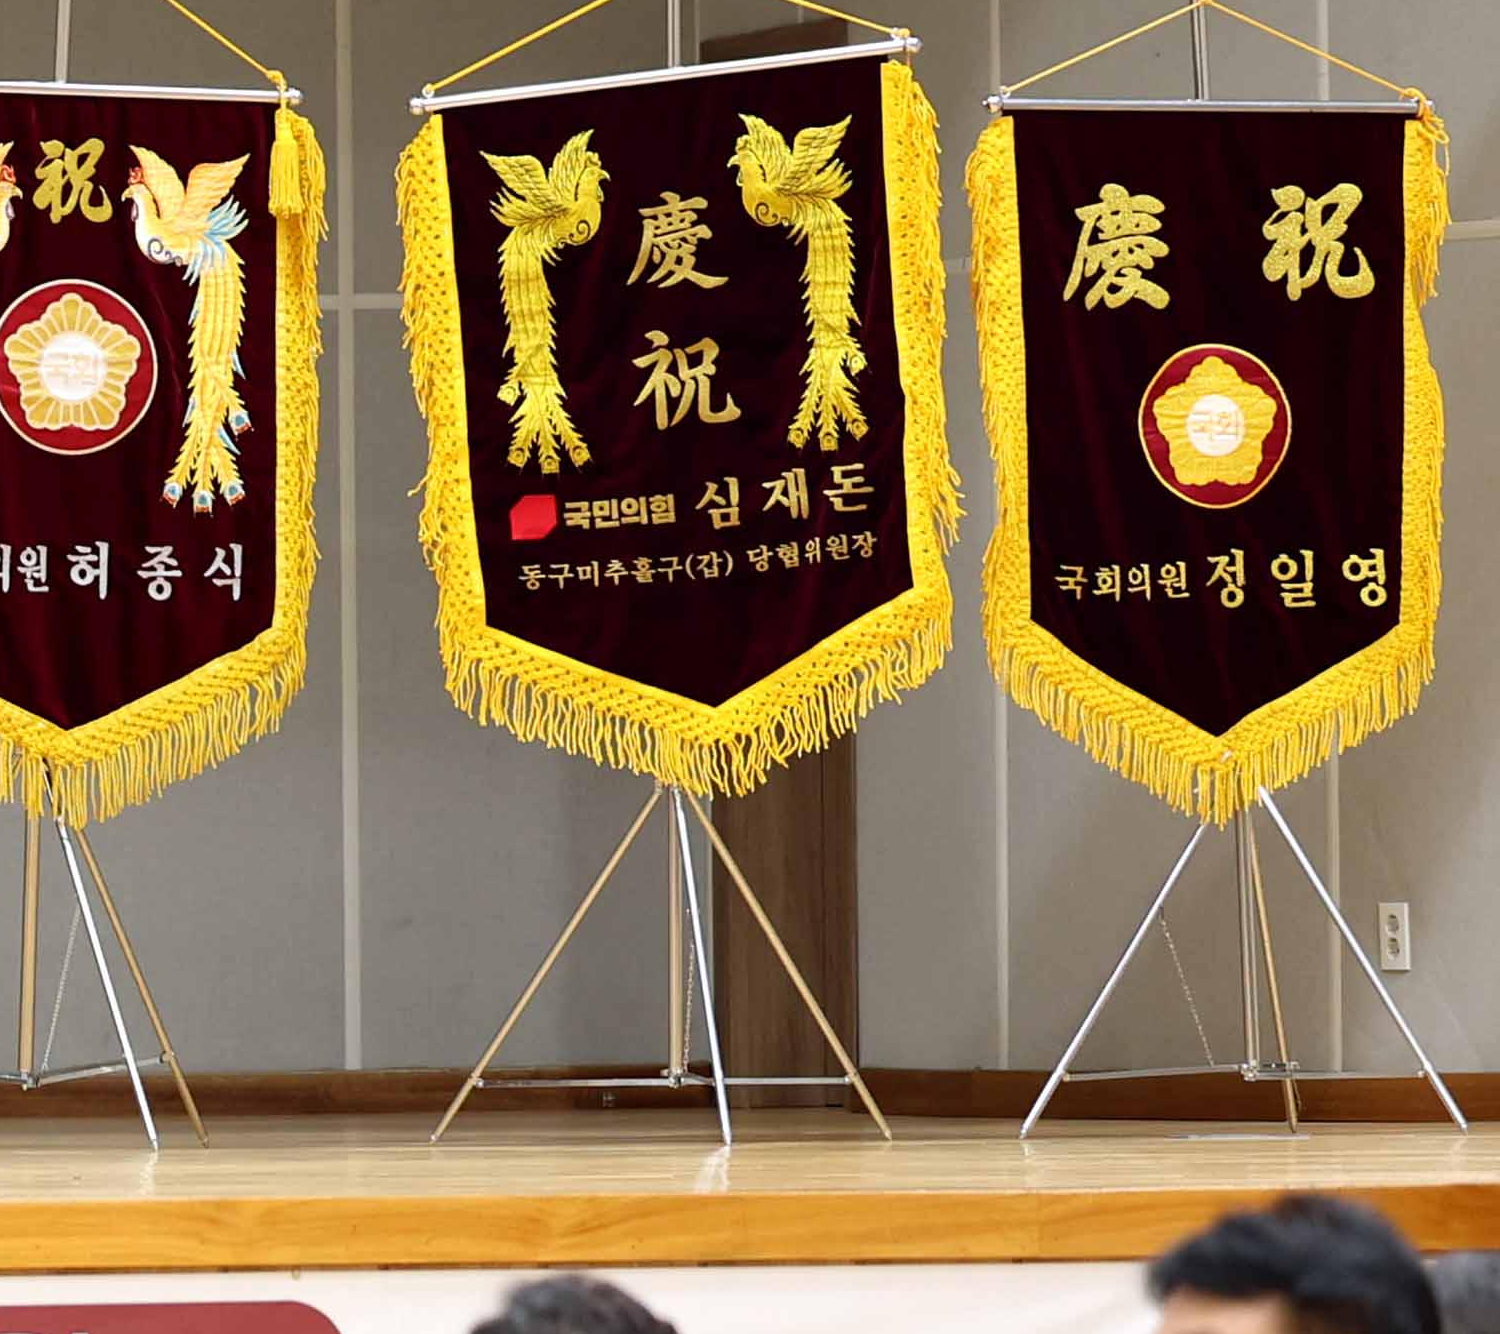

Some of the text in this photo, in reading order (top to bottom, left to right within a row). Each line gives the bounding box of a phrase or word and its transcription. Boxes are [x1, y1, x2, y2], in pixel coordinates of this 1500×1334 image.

[32, 138, 114, 224] 祝
[562, 494, 677, 530] 국민의힘
[746, 530, 878, 573] 당협위원장
[1054, 562, 1190, 602] 국회의원
